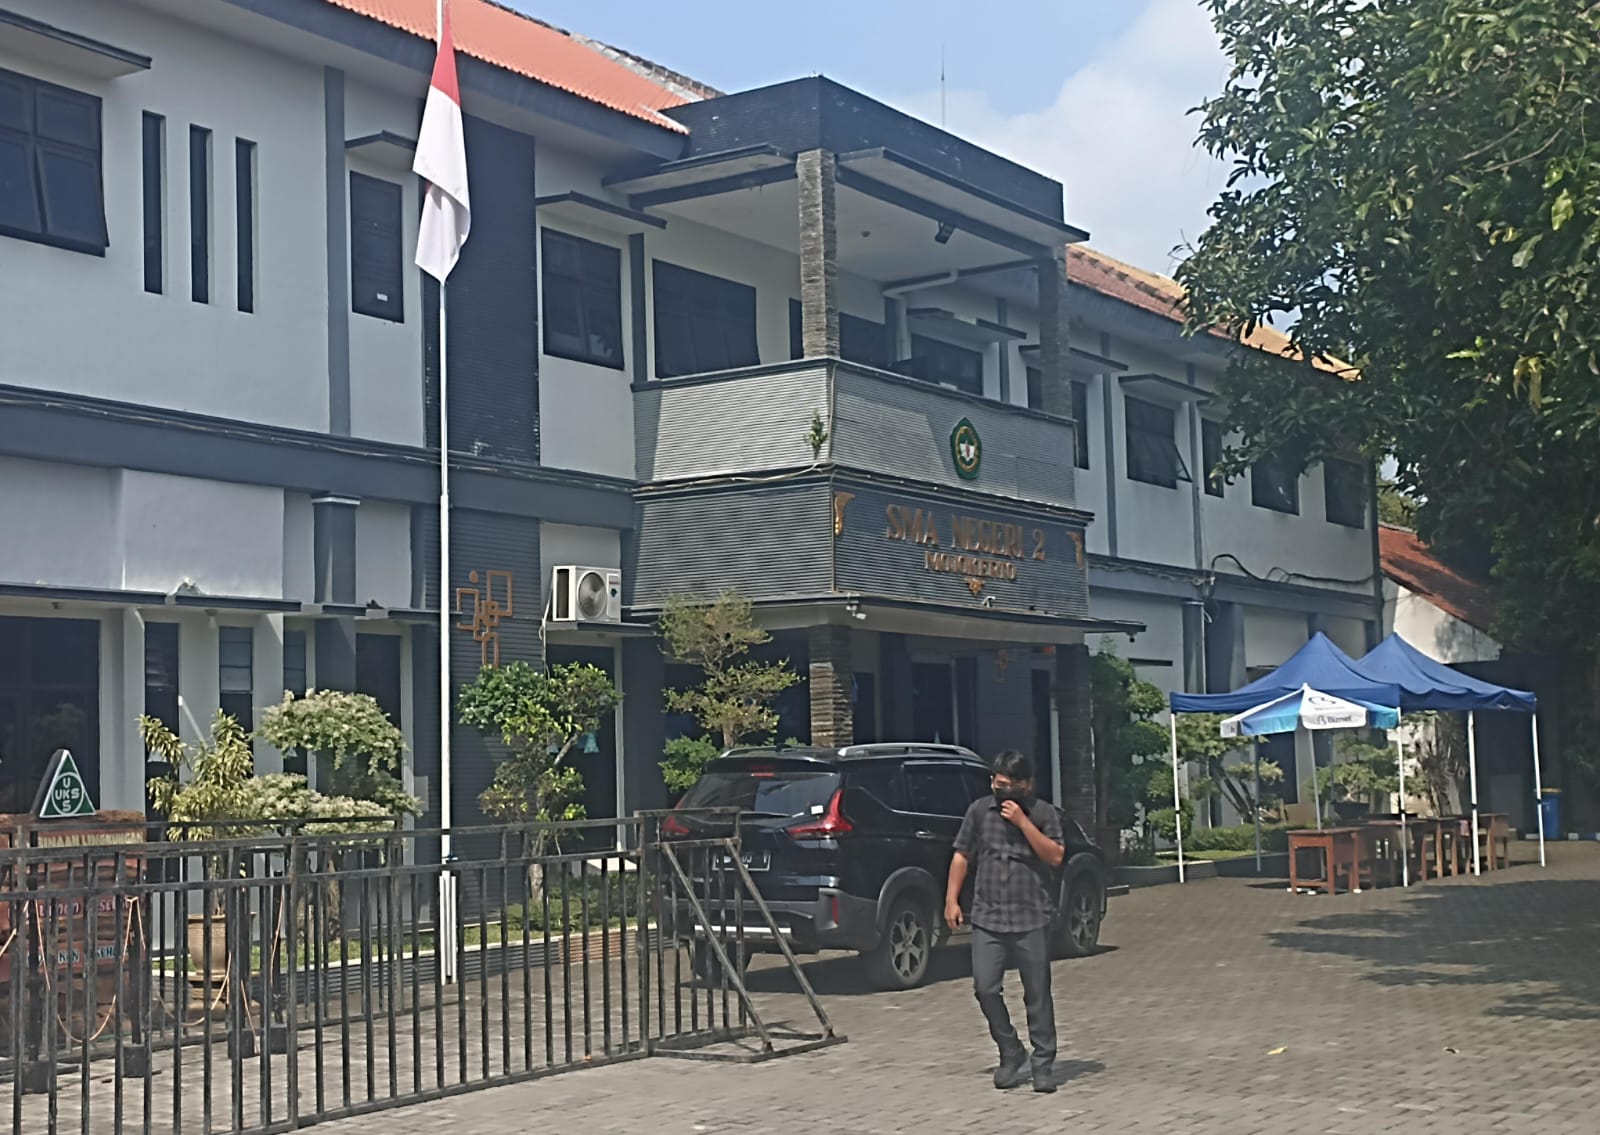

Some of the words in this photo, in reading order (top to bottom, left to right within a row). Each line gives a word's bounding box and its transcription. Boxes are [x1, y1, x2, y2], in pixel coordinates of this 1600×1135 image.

[886, 503, 939, 545] SMA
[952, 514, 1025, 558] NEGERI
[1032, 528, 1046, 561] 2
[55, 788, 80, 800] UKS
